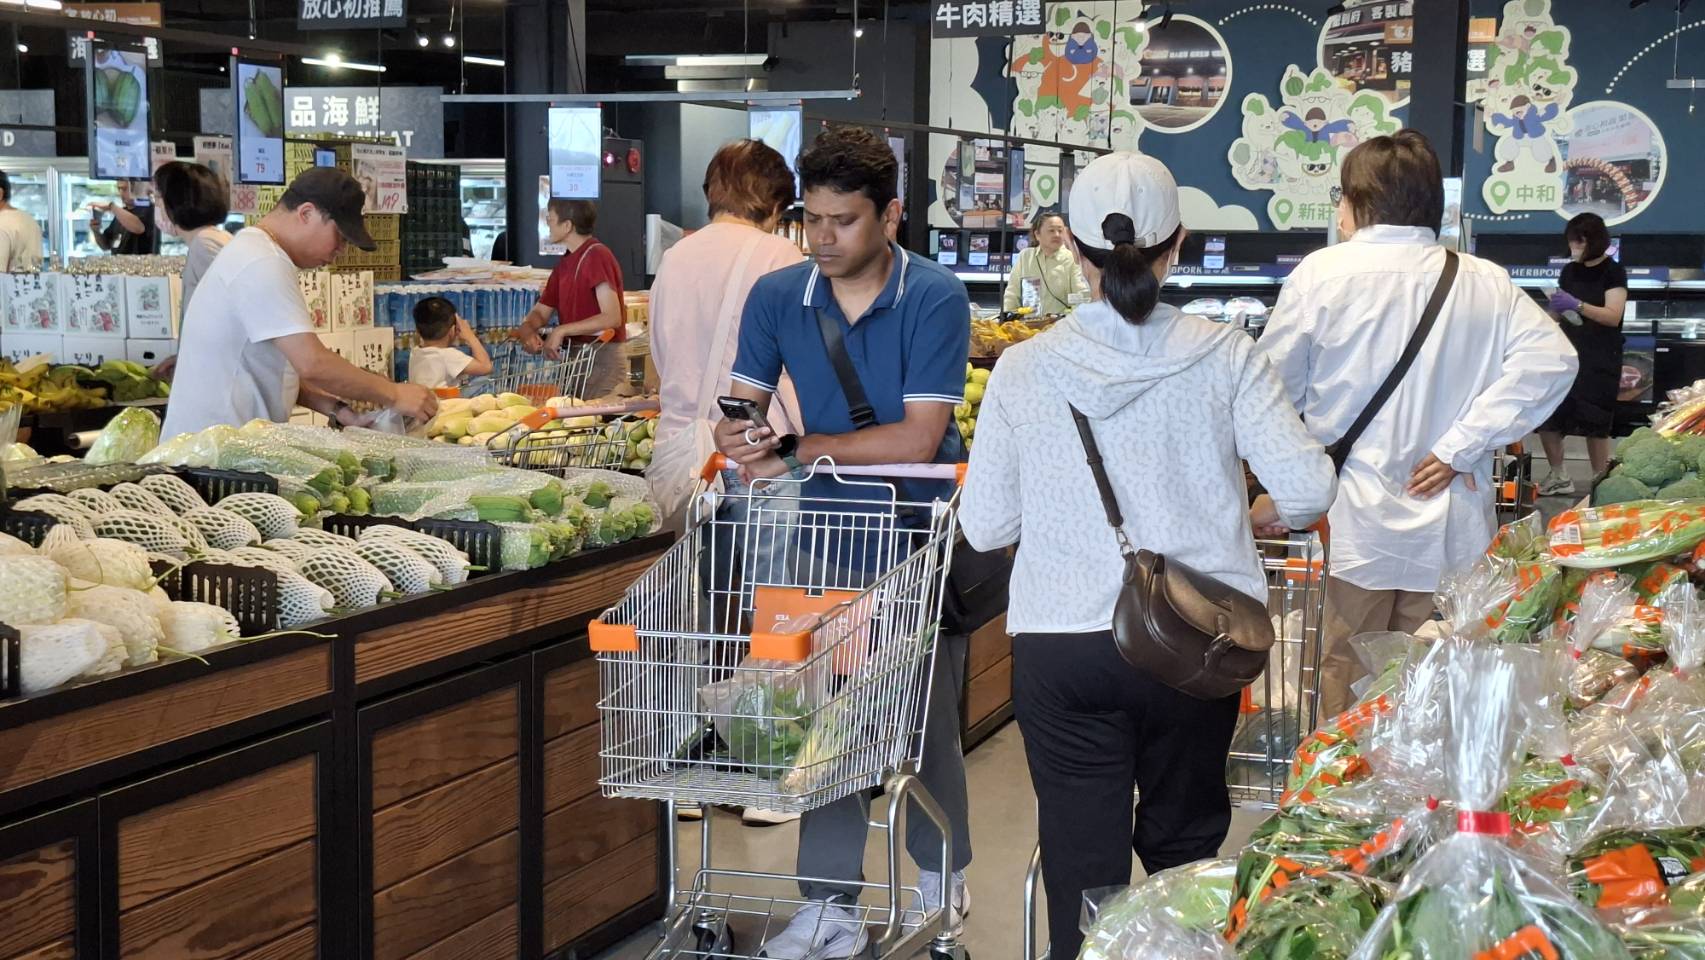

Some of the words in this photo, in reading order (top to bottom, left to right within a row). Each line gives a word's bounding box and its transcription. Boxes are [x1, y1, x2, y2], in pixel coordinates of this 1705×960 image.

[936, 0, 1041, 28] 牛肉精選
[291, 95, 380, 127] 品海鮮
[1516, 184, 1555, 202] 中和
